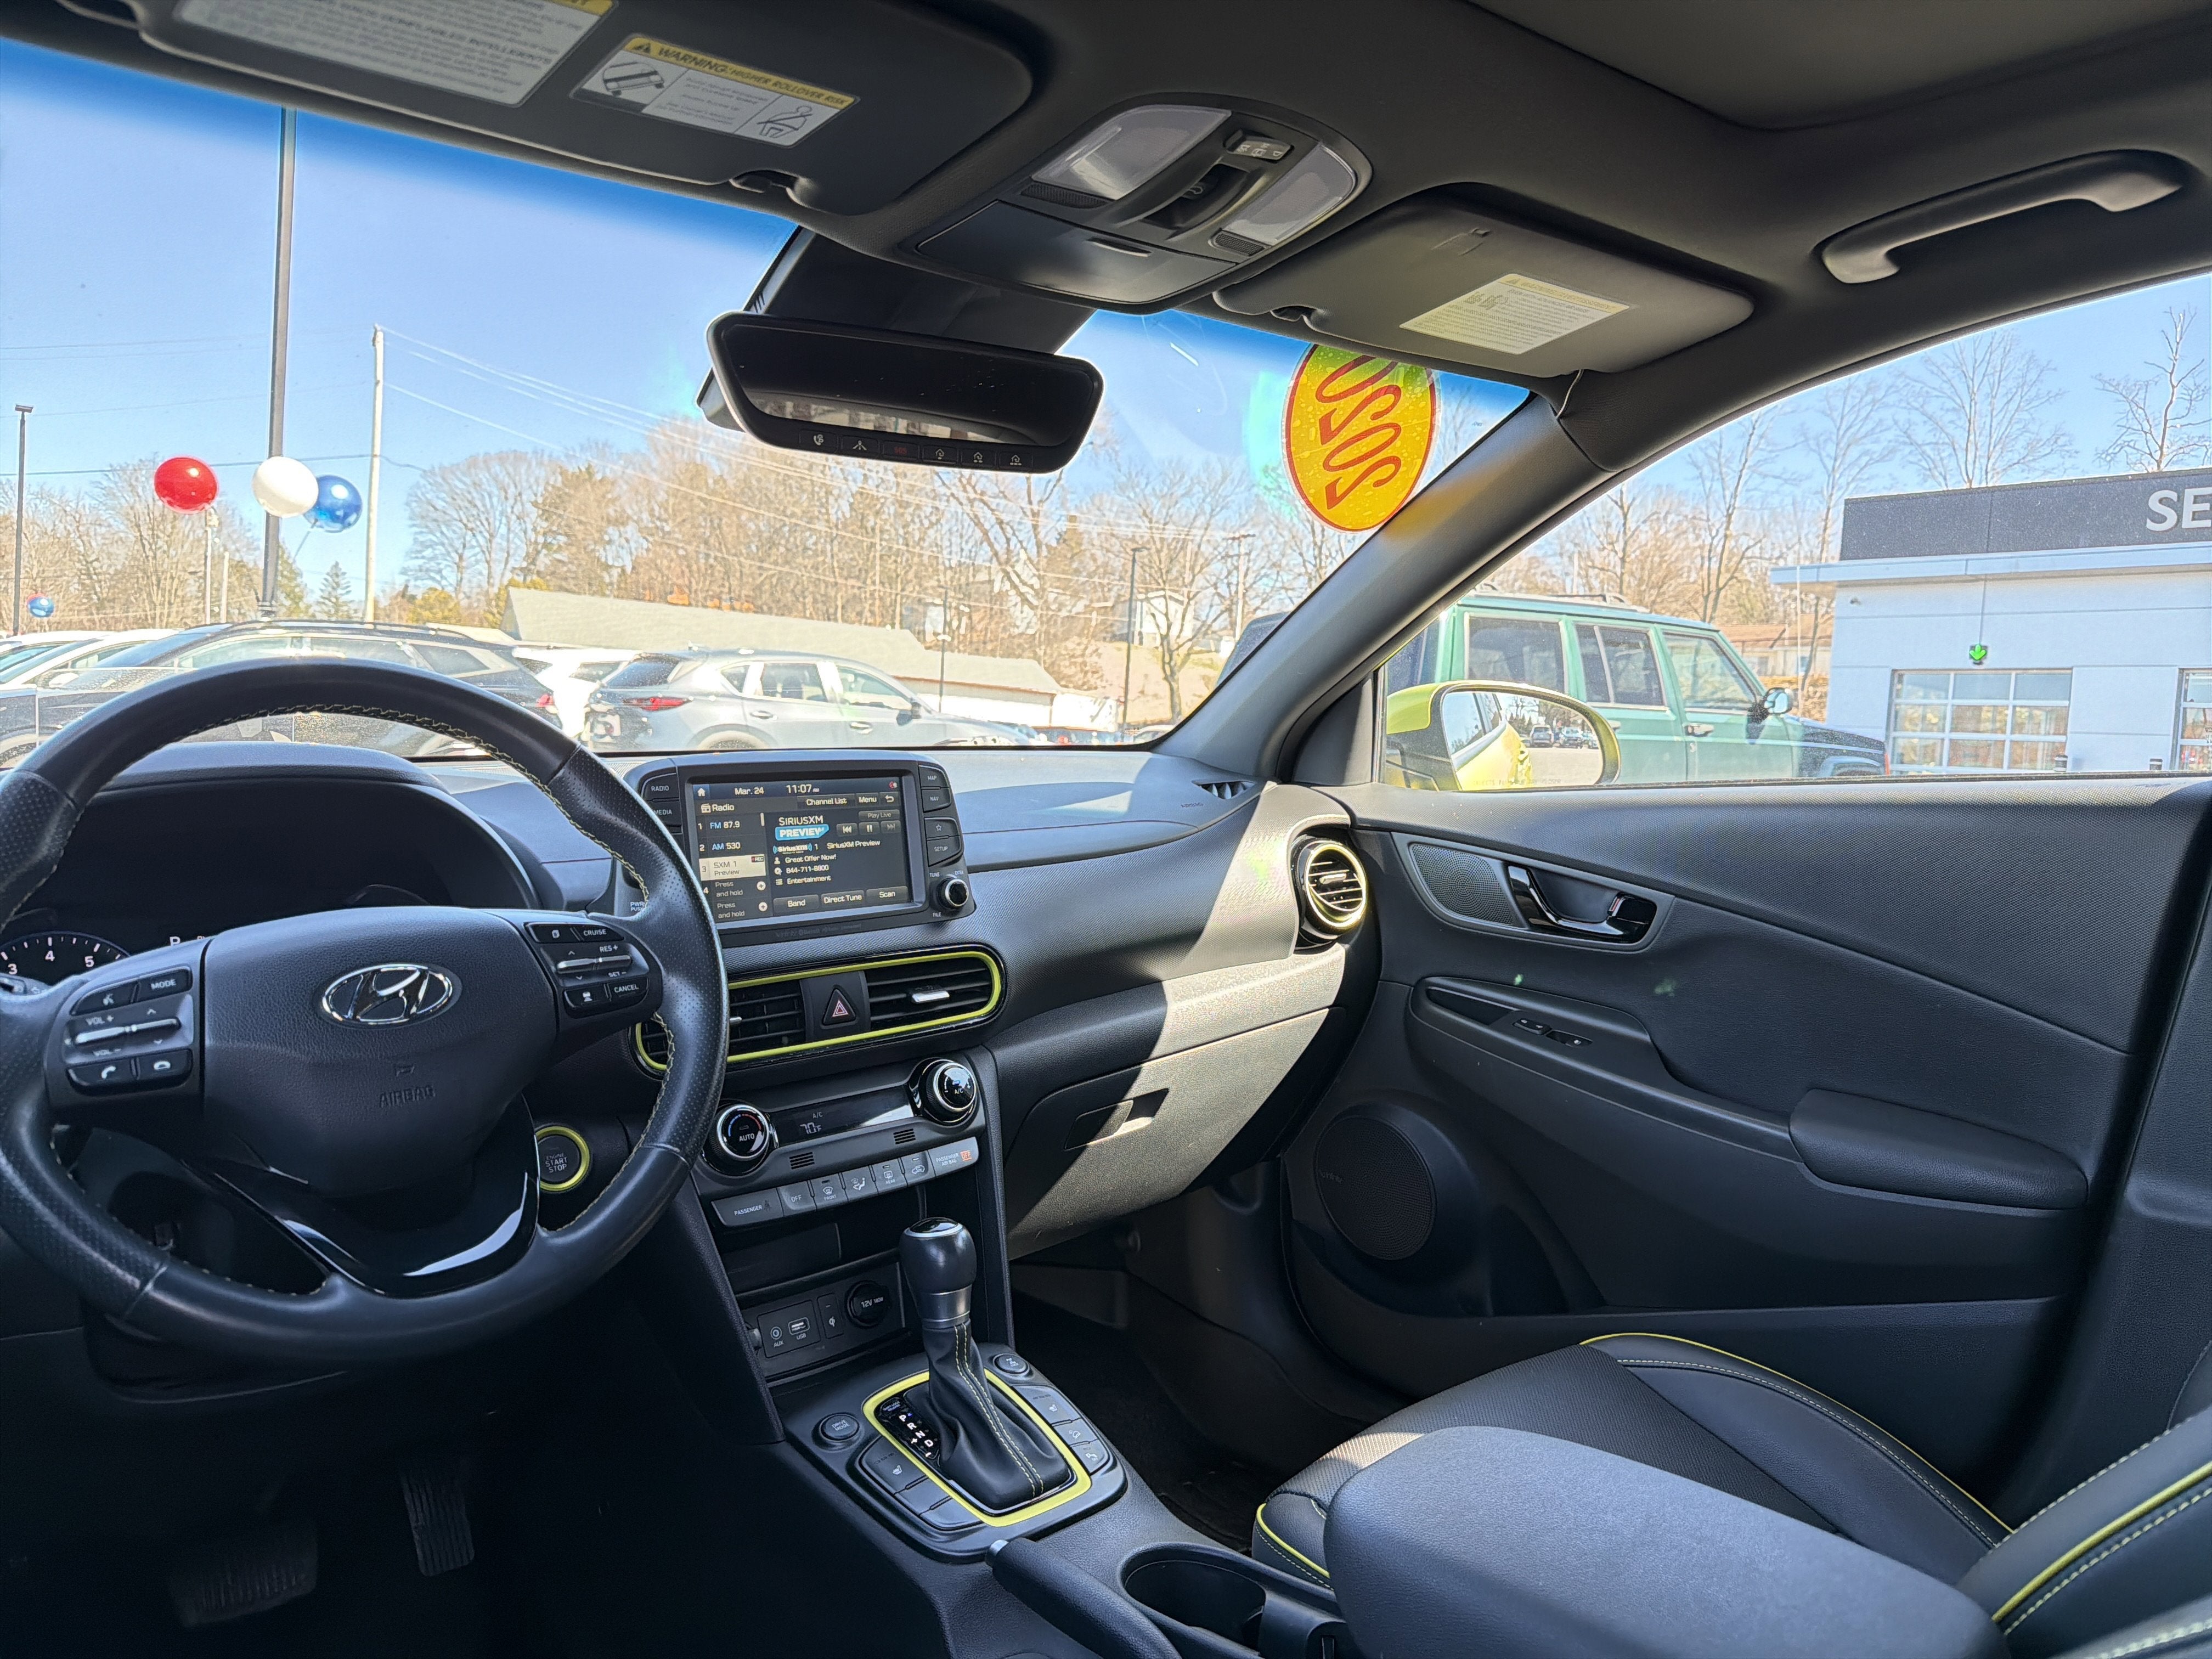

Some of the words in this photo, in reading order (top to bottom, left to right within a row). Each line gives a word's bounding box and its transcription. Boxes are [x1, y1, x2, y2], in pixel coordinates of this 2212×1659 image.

[772, 80, 825, 99] ROLLOVER
[824, 95, 849, 105] RISK
[2146, 487, 2212, 531] SE
[754, 786, 764, 794] 24
[786, 784, 812, 794] 11:07
[806, 797, 834, 806] Channel
[712, 804, 735, 812] Radio
[723, 821, 741, 829] 87.9
[778, 815, 823, 826] SIRIUSXM
[780, 827, 826, 838] PREVIEW
[827, 841, 854, 849] SiriusXM
[785, 855, 804, 864] Great
[787, 874, 832, 885] Entertainment
[787, 899, 806, 907] Band
[823, 895, 845, 904] Direct
[845, 894, 862, 902] Tune
[170, 936, 180, 946] P
[45, 951, 55, 961] 4
[84, 956, 94, 967] 5
[8, 964, 18, 974] 3
[151, 979, 177, 990] MODE
[614, 984, 639, 993] CANCEL
[86, 1017, 105, 1025] VOL
[379, 1085, 436, 1108] AIRBAG
[739, 1133, 755, 1142] AUTO
[545, 1156, 567, 1167] START
[935, 1153, 959, 1163] PASSENGER
[961, 1152, 971, 1160] OFF
[549, 1164, 567, 1173] STOP
[791, 1194, 802, 1203] OFF
[733, 1205, 763, 1216] PASSENGER
[861, 1299, 873, 1308] 12V
[831, 1419, 847, 1429] DRIVE
[834, 1423, 850, 1431] MODE
[907, 1422, 917, 1430] R
[915, 1430, 926, 1438] N
[924, 1439, 934, 1447] D
